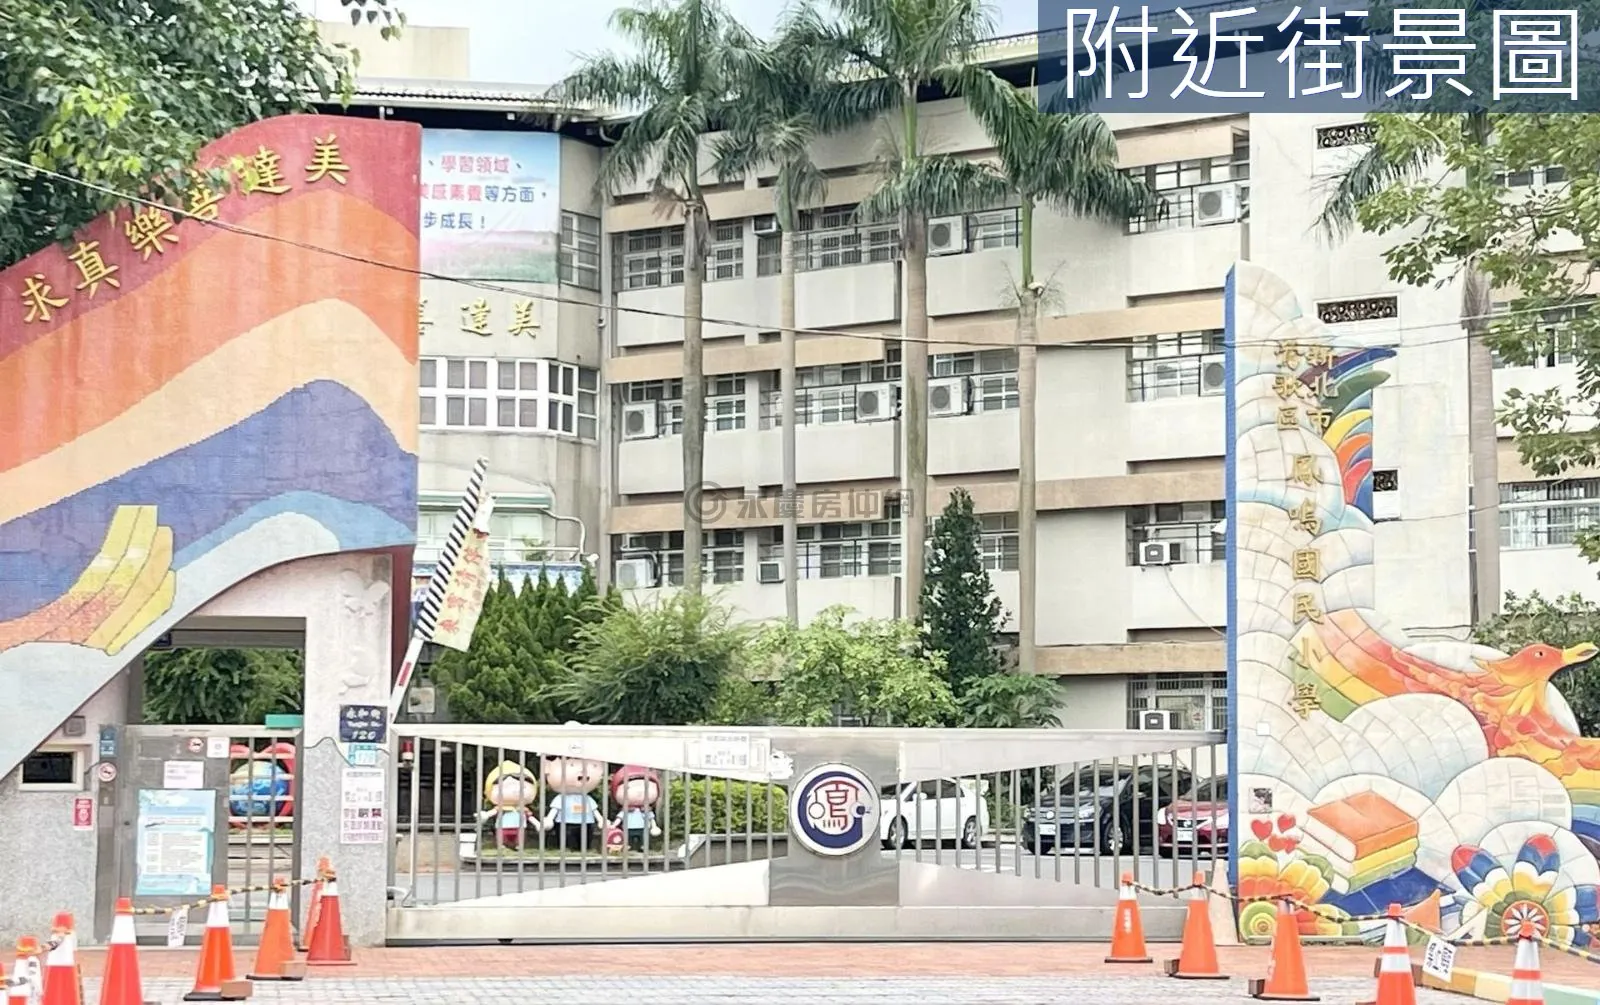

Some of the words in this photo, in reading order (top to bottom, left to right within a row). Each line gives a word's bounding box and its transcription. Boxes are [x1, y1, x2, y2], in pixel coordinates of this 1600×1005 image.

[1306, 345, 1339, 436] 新北市
[1287, 453, 1324, 720] 鳳鳴國民小學
